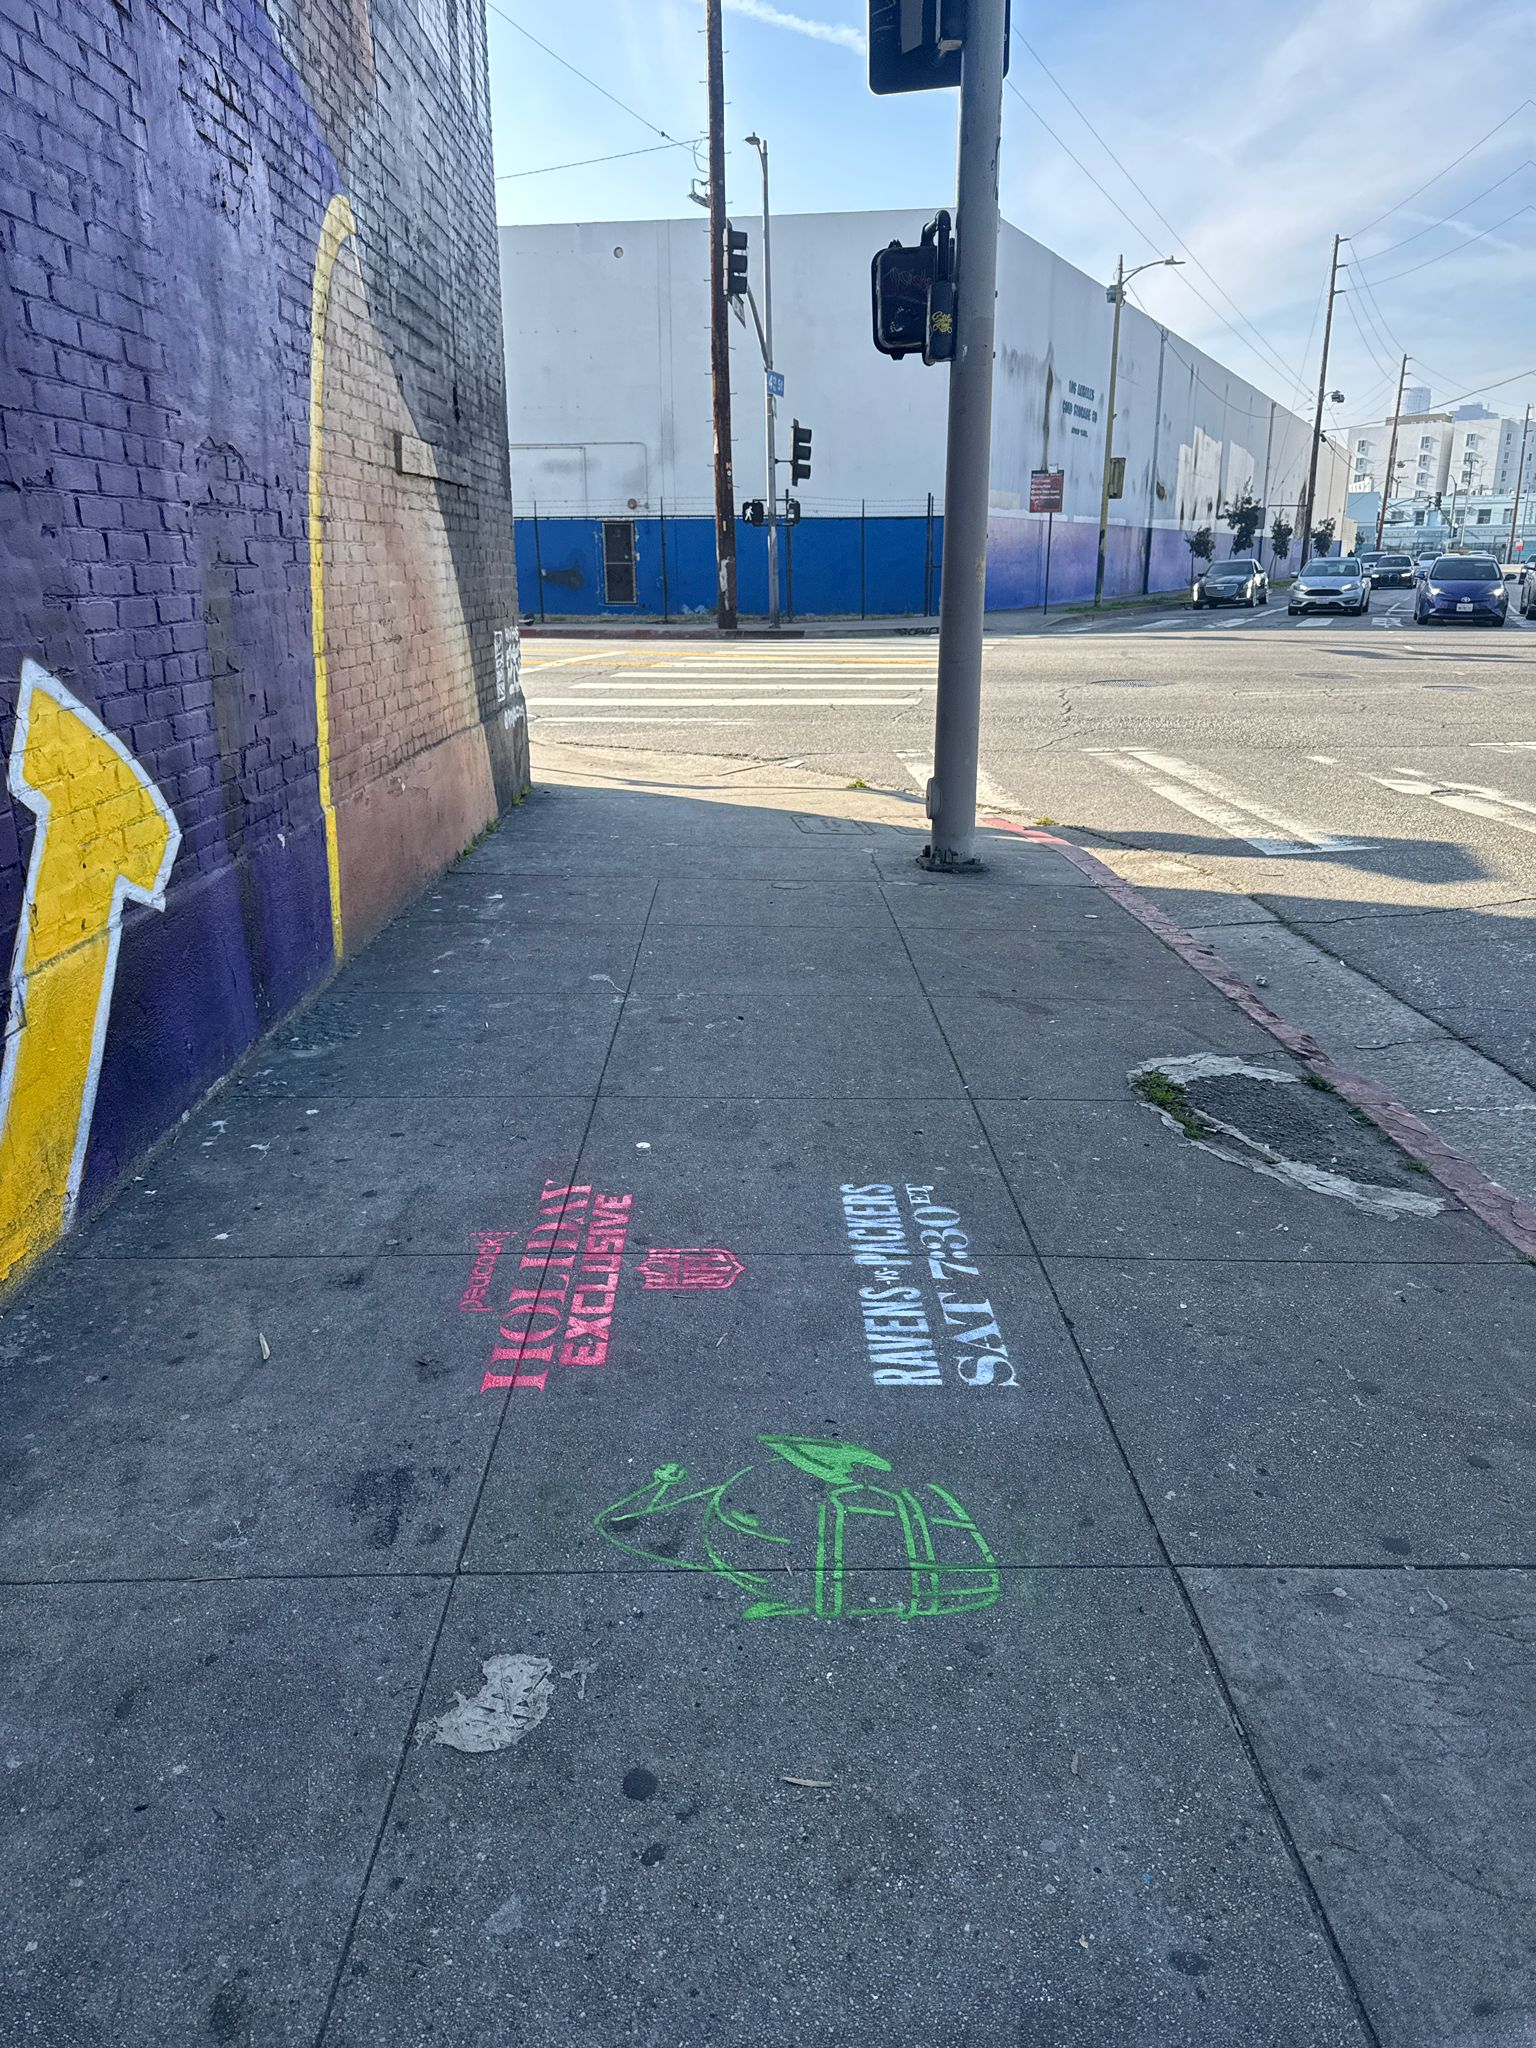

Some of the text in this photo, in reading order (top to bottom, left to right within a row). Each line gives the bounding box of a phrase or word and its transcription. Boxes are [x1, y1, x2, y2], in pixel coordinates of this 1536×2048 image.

[480, 1178, 592, 1395] HOLIDAY
[559, 1193, 633, 1366] EXCLUSIVE
[839, 1184, 913, 1265] PACKERS
[904, 1183, 1020, 1387] SAT 7:30 ET
[858, 1286, 943, 1386] RAVENS
